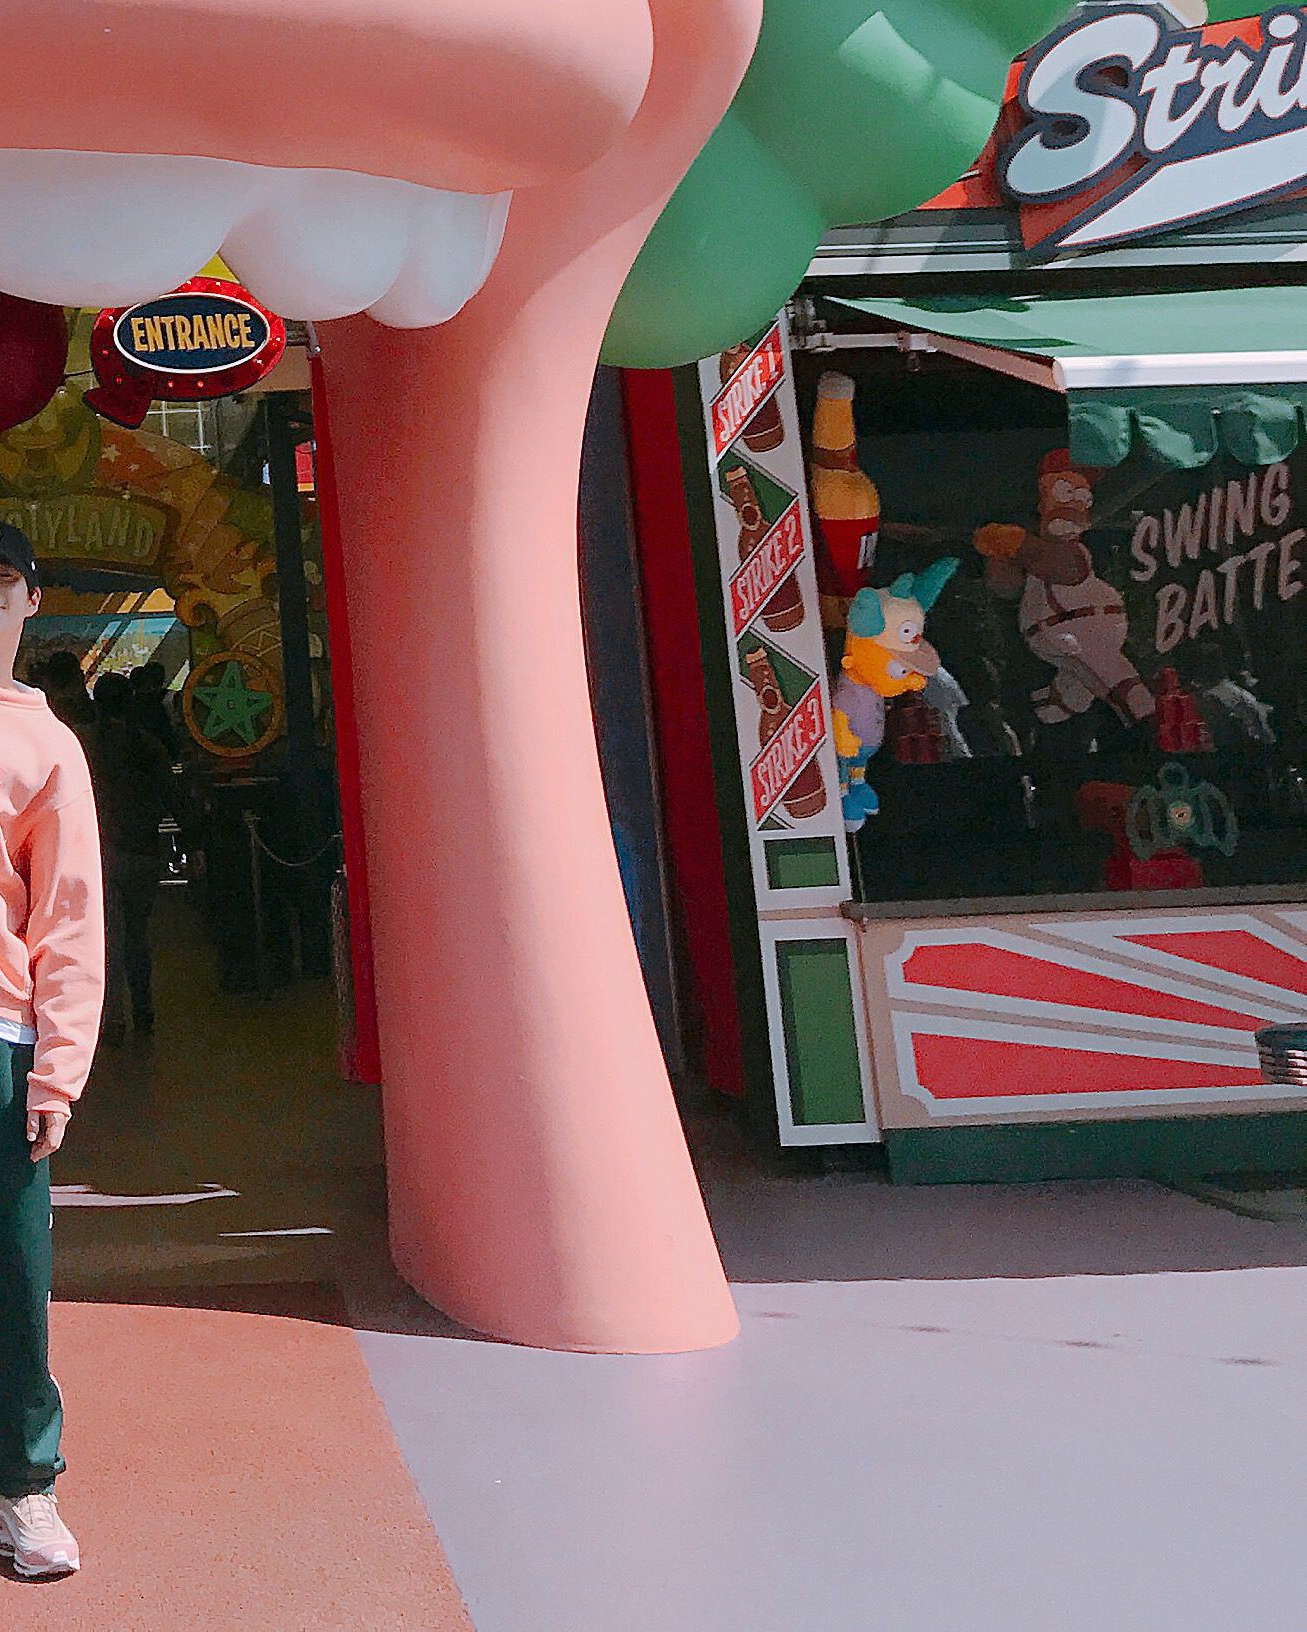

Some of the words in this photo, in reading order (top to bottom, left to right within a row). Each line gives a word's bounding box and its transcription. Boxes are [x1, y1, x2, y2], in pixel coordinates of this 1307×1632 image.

[130, 312, 256, 353] ENTRANCE
[716, 353, 767, 443] STRIKE
[764, 342, 780, 381] 1
[736, 530, 787, 620] STRIKE
[783, 514, 801, 556] 2
[1129, 463, 1292, 582] SWING
[756, 713, 810, 807] STRIKE
[806, 697, 822, 742] 3
